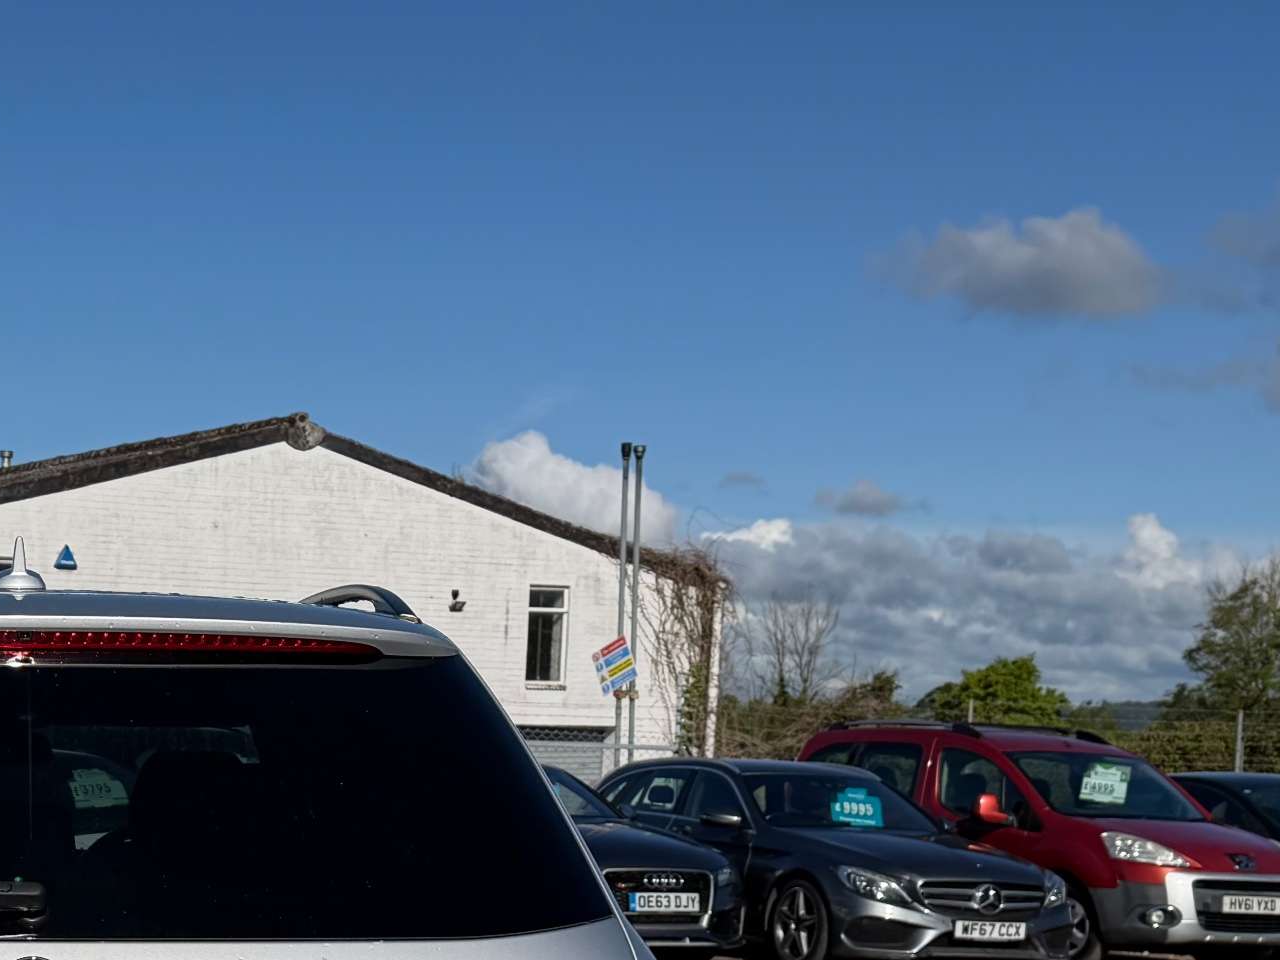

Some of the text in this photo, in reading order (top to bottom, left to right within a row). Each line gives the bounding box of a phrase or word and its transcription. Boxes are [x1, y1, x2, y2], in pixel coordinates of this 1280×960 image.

[638, 895, 697, 909] OE63 DJY
[961, 921, 1021, 937] WF67 CCX
